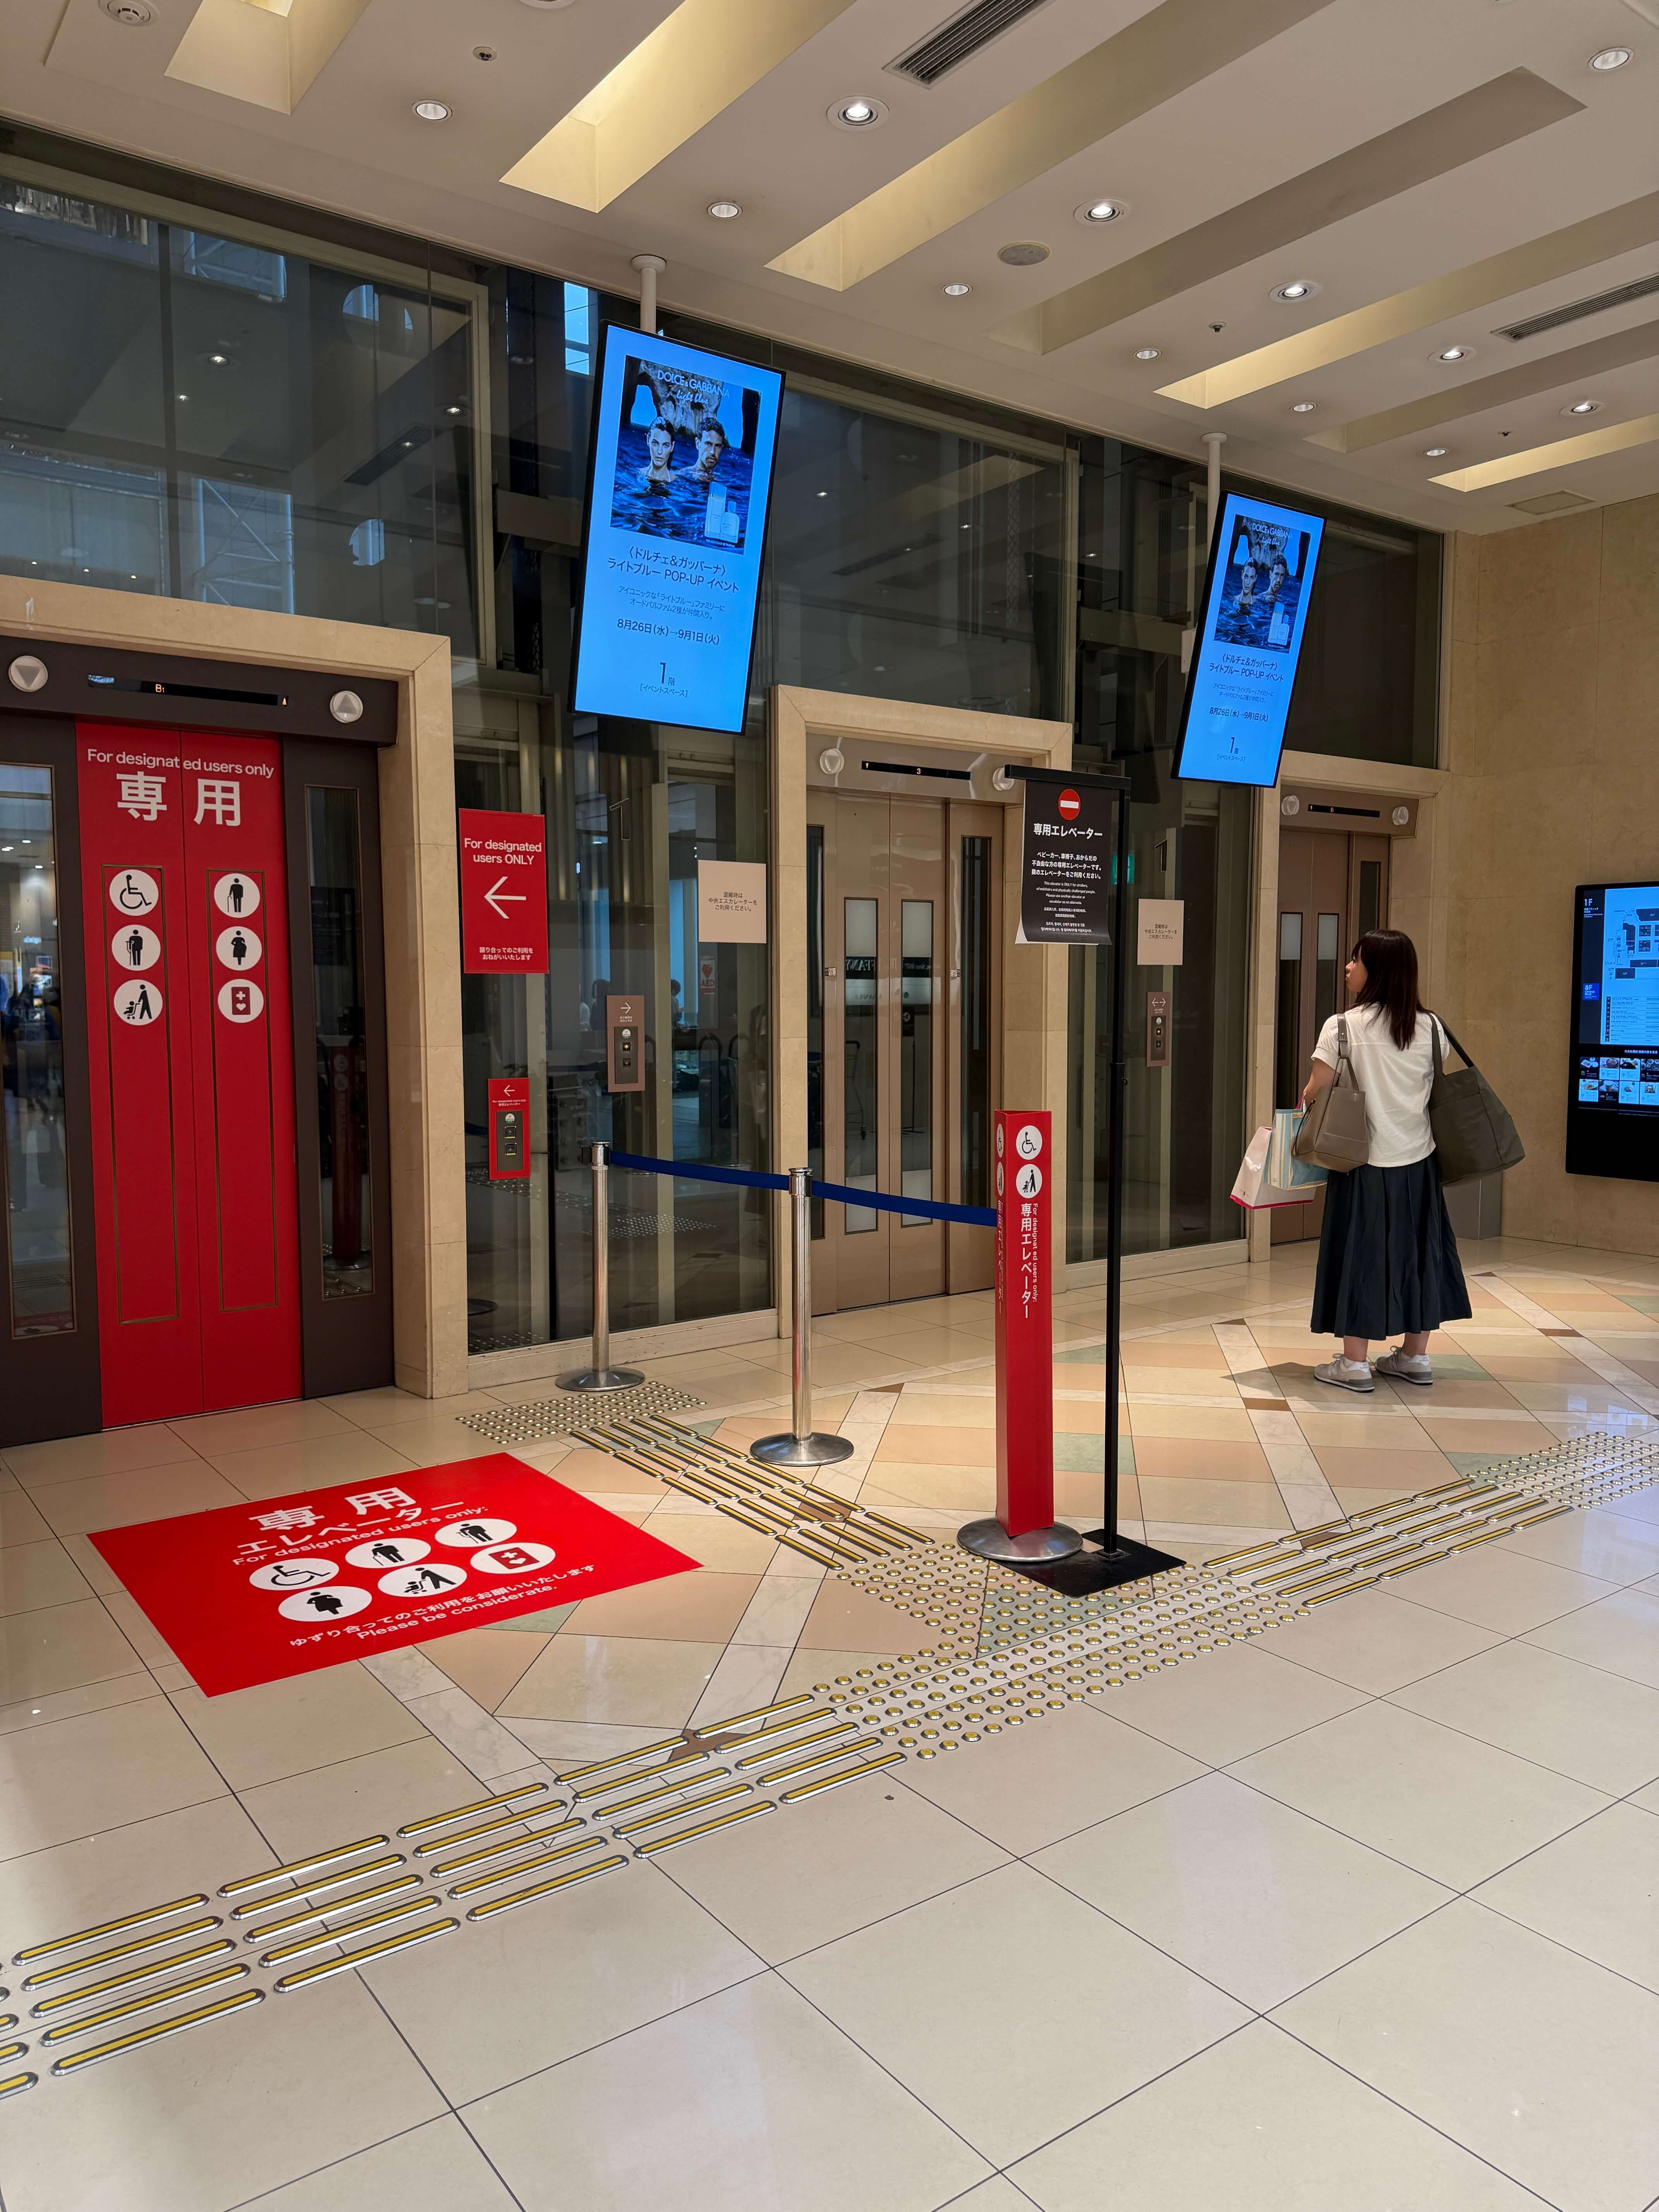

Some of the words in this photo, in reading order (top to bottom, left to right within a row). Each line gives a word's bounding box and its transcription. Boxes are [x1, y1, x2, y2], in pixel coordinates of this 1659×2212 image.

[677, 389, 693, 404] light
[694, 393, 709, 404] blue
[608, 557, 661, 576] ライトブルー
[665, 569, 704, 586] POP-UP
[707, 579, 739, 593] イベント
[1209, 663, 1240, 674] ライトブルー
[1241, 668, 1264, 679] POP-UP
[1265, 673, 1284, 682] イベント
[155, 684, 165, 693] B1
[88, 749, 113, 763] For
[203, 762, 242, 774] users
[245, 764, 274, 778] only
[116, 771, 240, 826] 専用
[464, 838, 483, 849] For
[485, 839, 542, 852] designated
[1033, 823, 1103, 839] 専用エレベーター
[473, 854, 502, 863] users
[505, 854, 534, 865] ONLY
[1032, 860, 1101, 871] 不自由な方の専用エレベーターです。
[701, 979, 715, 987] AED
[1021, 1203, 1032, 1318] 専用エレベーター
[248, 1487, 417, 1531] 専用
[232, 1553, 268, 1566] For
[274, 1528, 384, 1557] designated
[388, 1517, 441, 1532] users
[445, 1506, 489, 1520] only:
[237, 1501, 464, 1555] エレベーター
[290, 1564, 595, 1647] ゆずり合ってのご利用をお願いいたします
[356, 1619, 420, 1640] Please
[424, 1609, 454, 1622] be
[460, 1585, 558, 1614] considerate.
